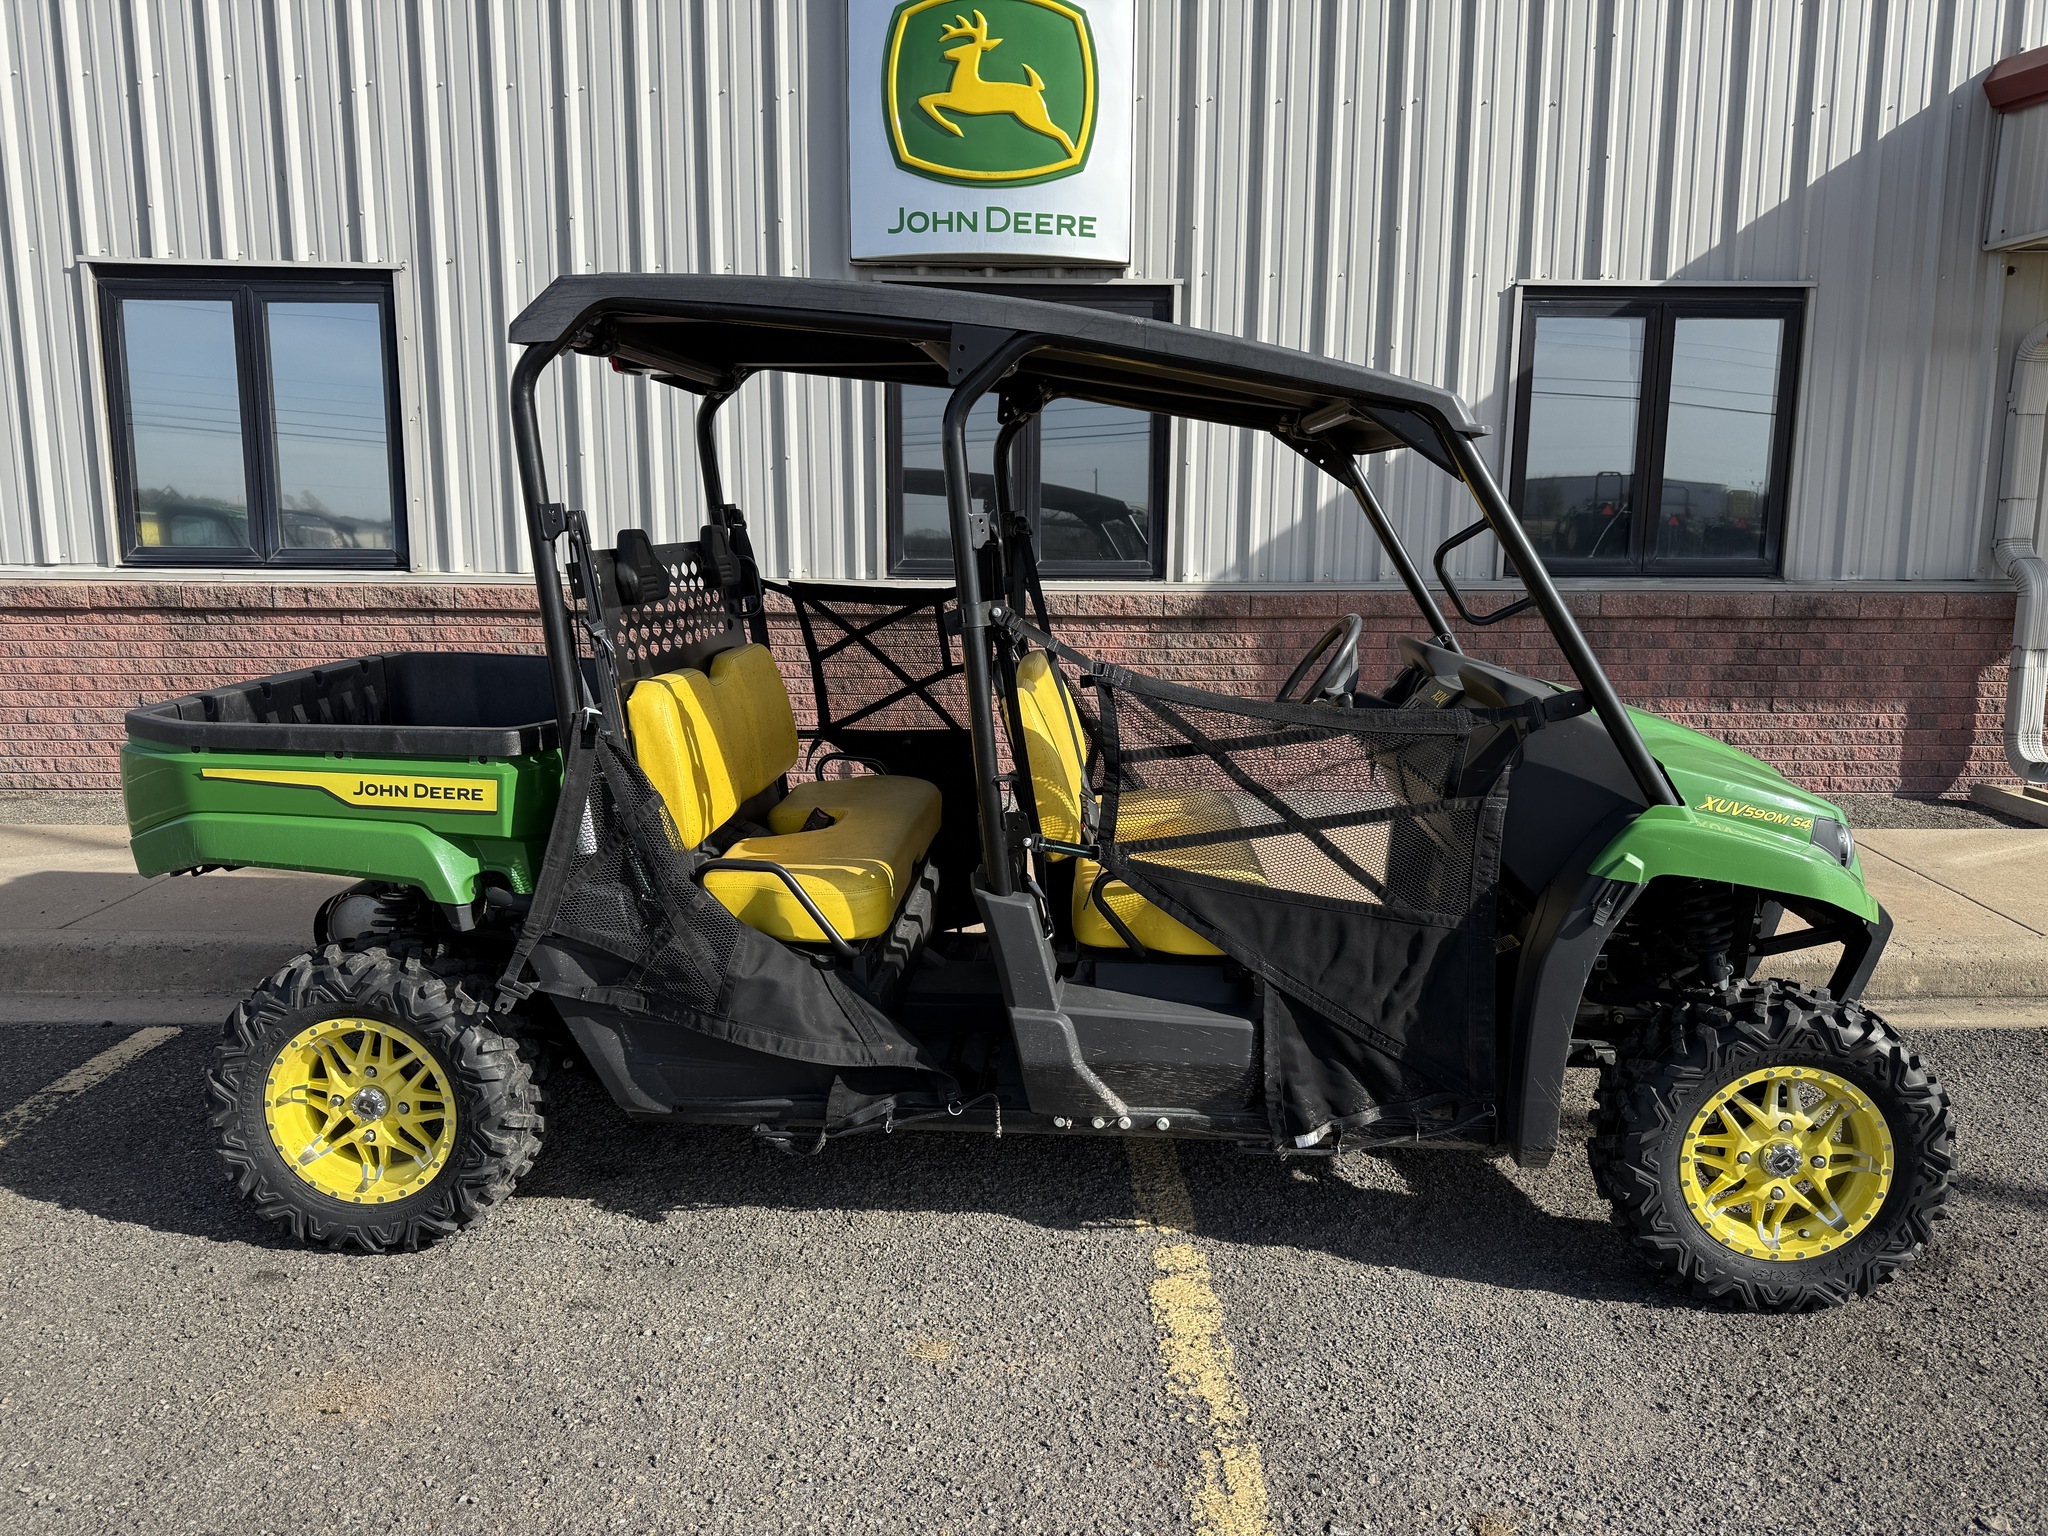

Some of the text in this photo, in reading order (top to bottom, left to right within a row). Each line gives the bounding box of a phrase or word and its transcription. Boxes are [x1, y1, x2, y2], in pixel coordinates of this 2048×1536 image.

[888, 206, 1097, 238] JOHN DEERE
[1430, 689, 1450, 705] XUV
[353, 781, 484, 801] JOHN DEERE
[1694, 795, 1813, 830] XUV590M S4
[240, 1059, 270, 1161] BIGHORN
